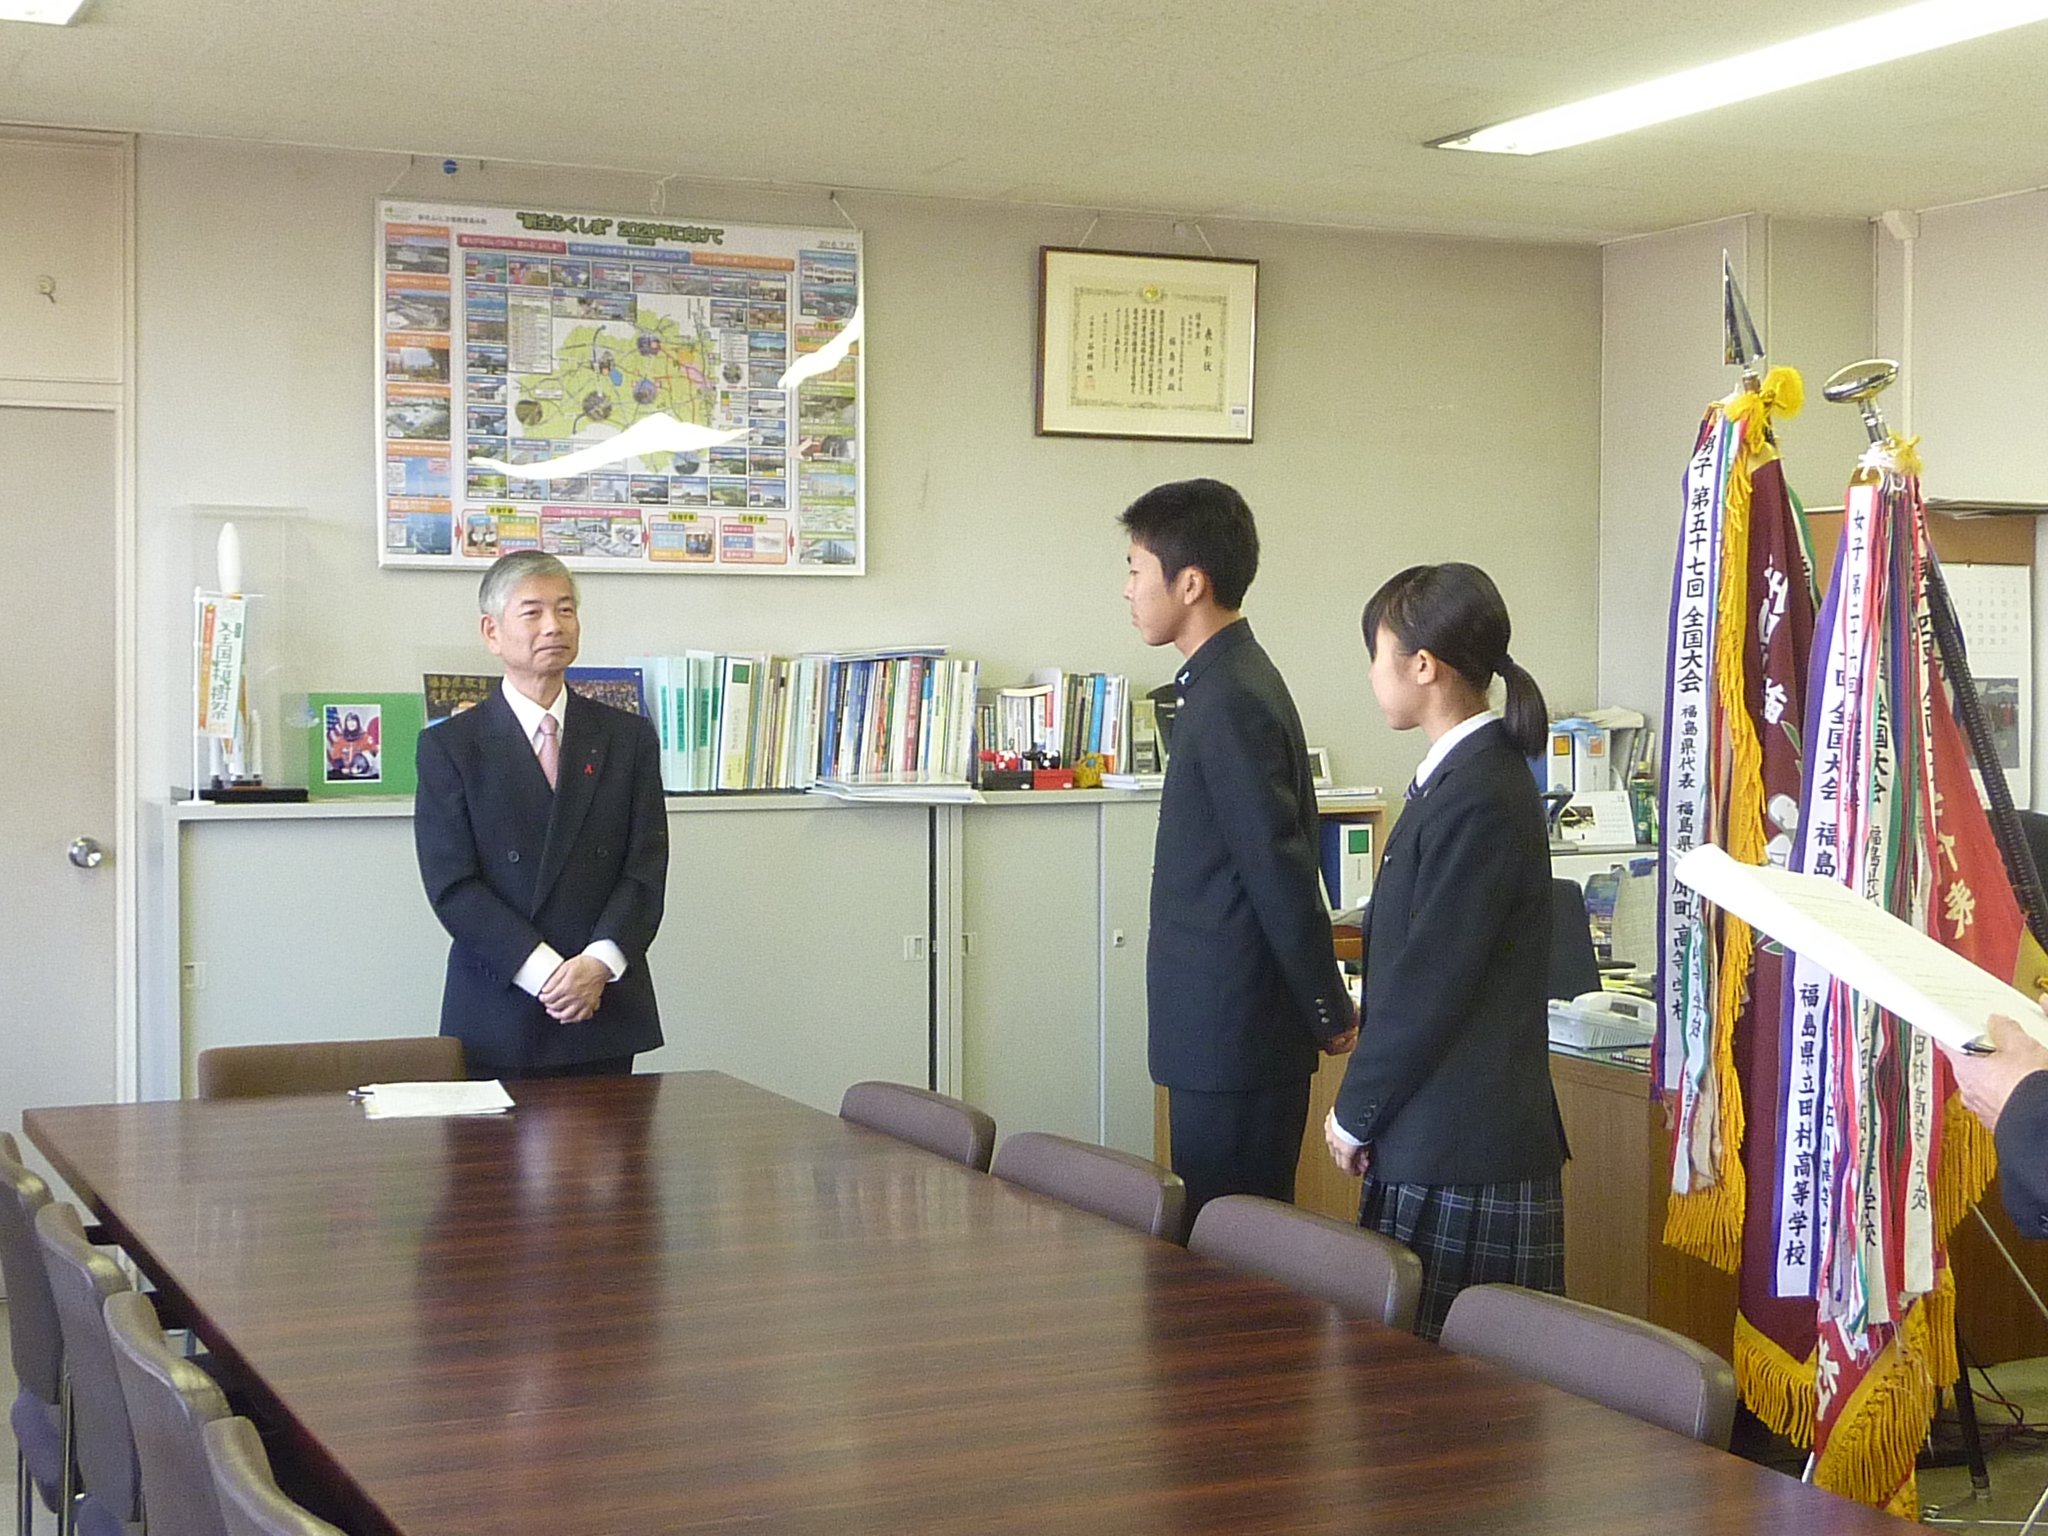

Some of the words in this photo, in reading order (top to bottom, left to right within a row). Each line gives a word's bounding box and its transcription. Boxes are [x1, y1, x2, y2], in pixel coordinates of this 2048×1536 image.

[617, 219, 725, 244] 2020年に向けて
[1692, 434, 1717, 478] 男子
[1685, 487, 1711, 600] 第五十七回
[1852, 509, 1866, 561] 女子
[1676, 604, 1706, 694] 全国大会
[1677, 704, 1699, 789] 福島県代表
[1819, 703, 1846, 801] 全国大会
[1813, 820, 1838, 878] 福島
[1784, 981, 1820, 1267] 福島県立田村高等学校
